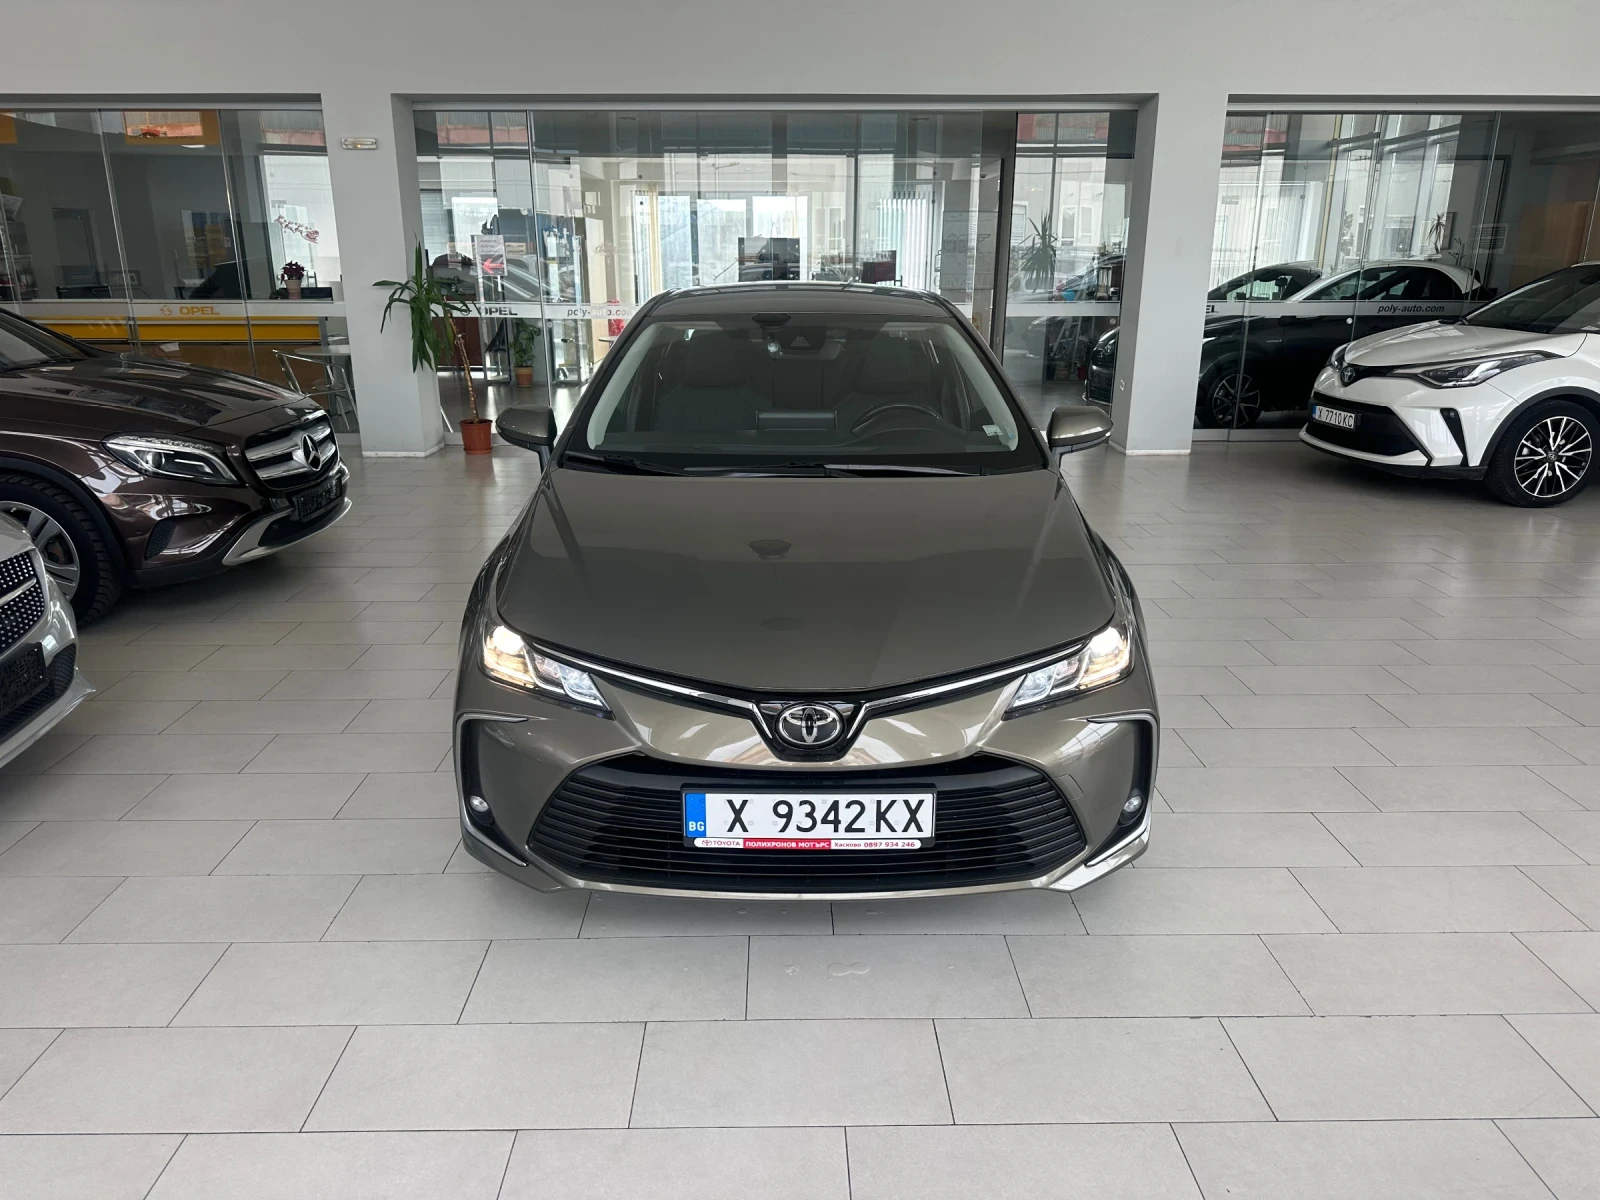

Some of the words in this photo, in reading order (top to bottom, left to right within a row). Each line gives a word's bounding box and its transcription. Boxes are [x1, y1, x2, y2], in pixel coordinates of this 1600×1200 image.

[179, 305, 220, 316] OPEL
[1377, 304, 1445, 314] poly-auto.com
[726, 799, 749, 833] X
[688, 821, 705, 831] BG
